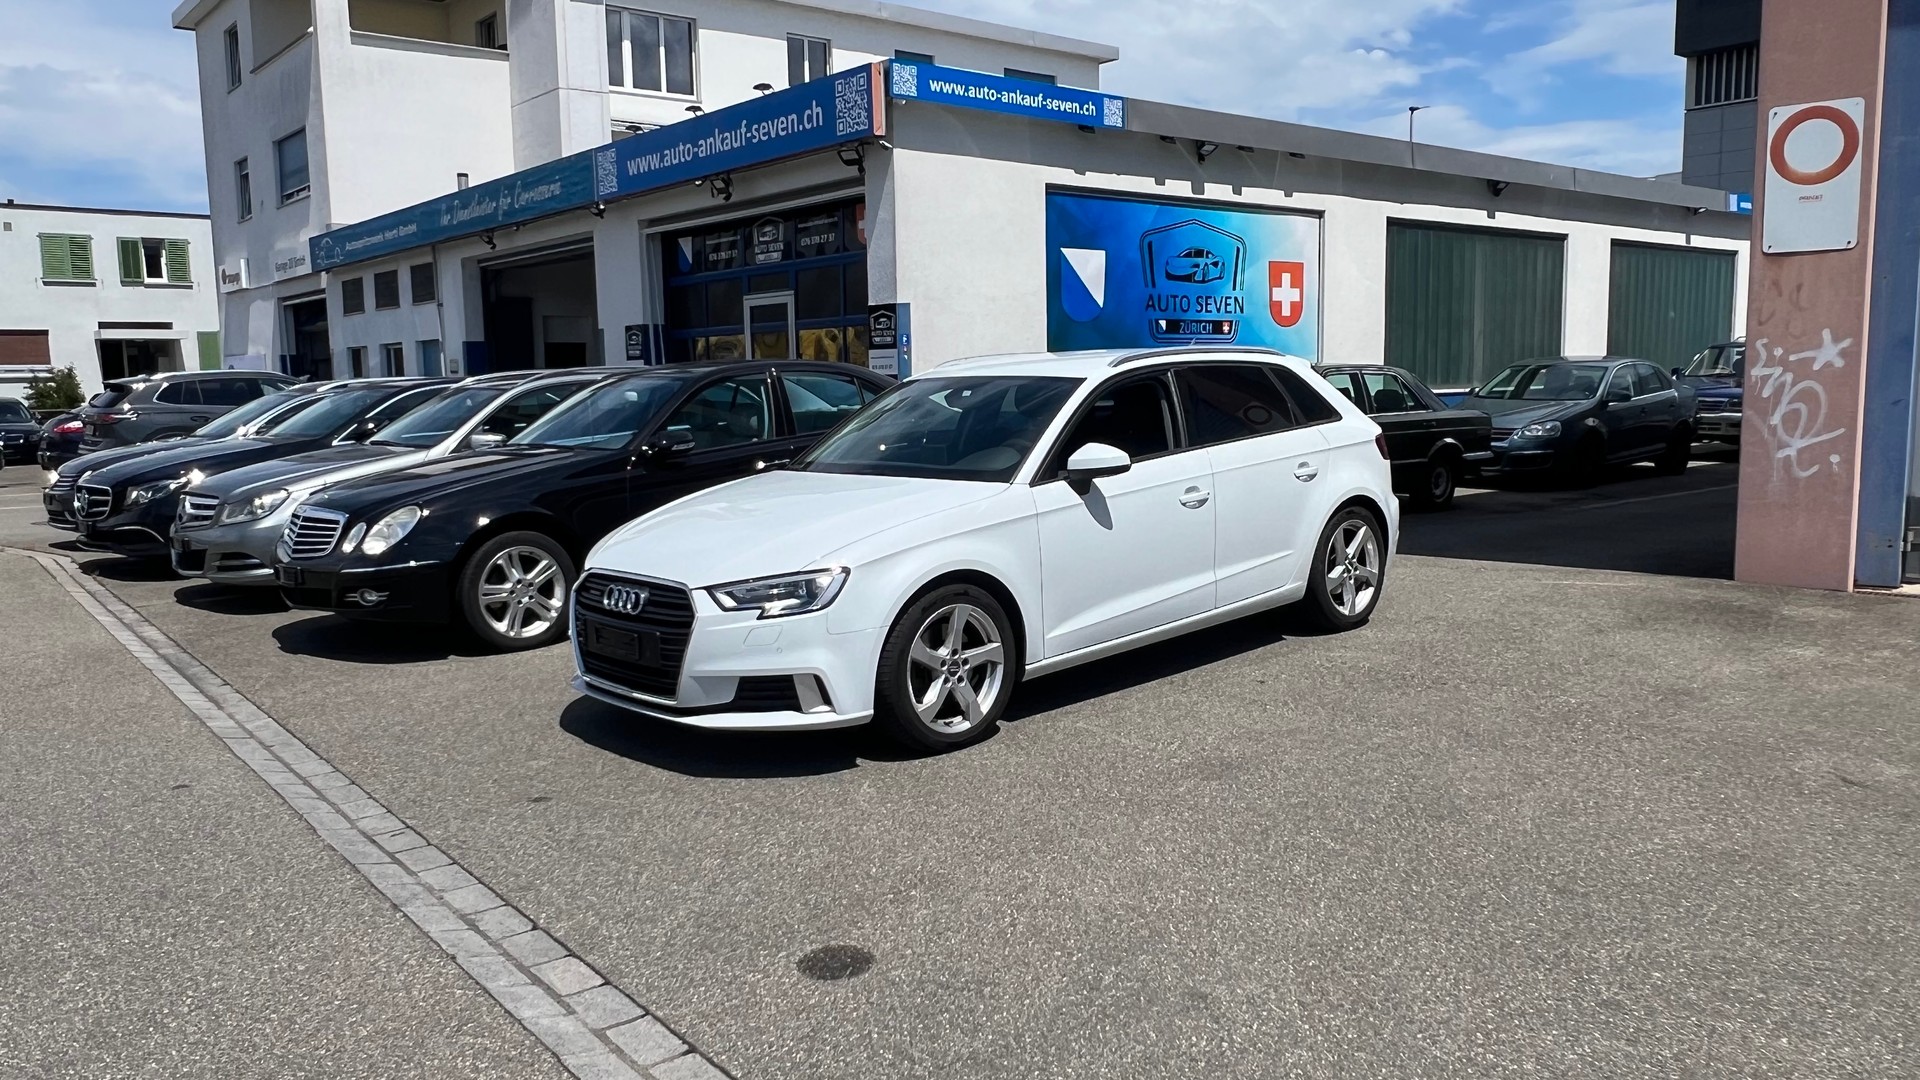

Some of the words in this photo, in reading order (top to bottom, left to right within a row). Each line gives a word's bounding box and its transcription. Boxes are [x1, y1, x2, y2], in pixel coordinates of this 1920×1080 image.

[929, 79, 1096, 117] www.auto-ankauf-seven.ch
[627, 100, 824, 176] www.auto-ankauf-seven.ch
[1145, 293, 1191, 313] AUTO
[1195, 295, 1244, 314] SEVEN
[1179, 320, 1213, 334] ZÜRICH
